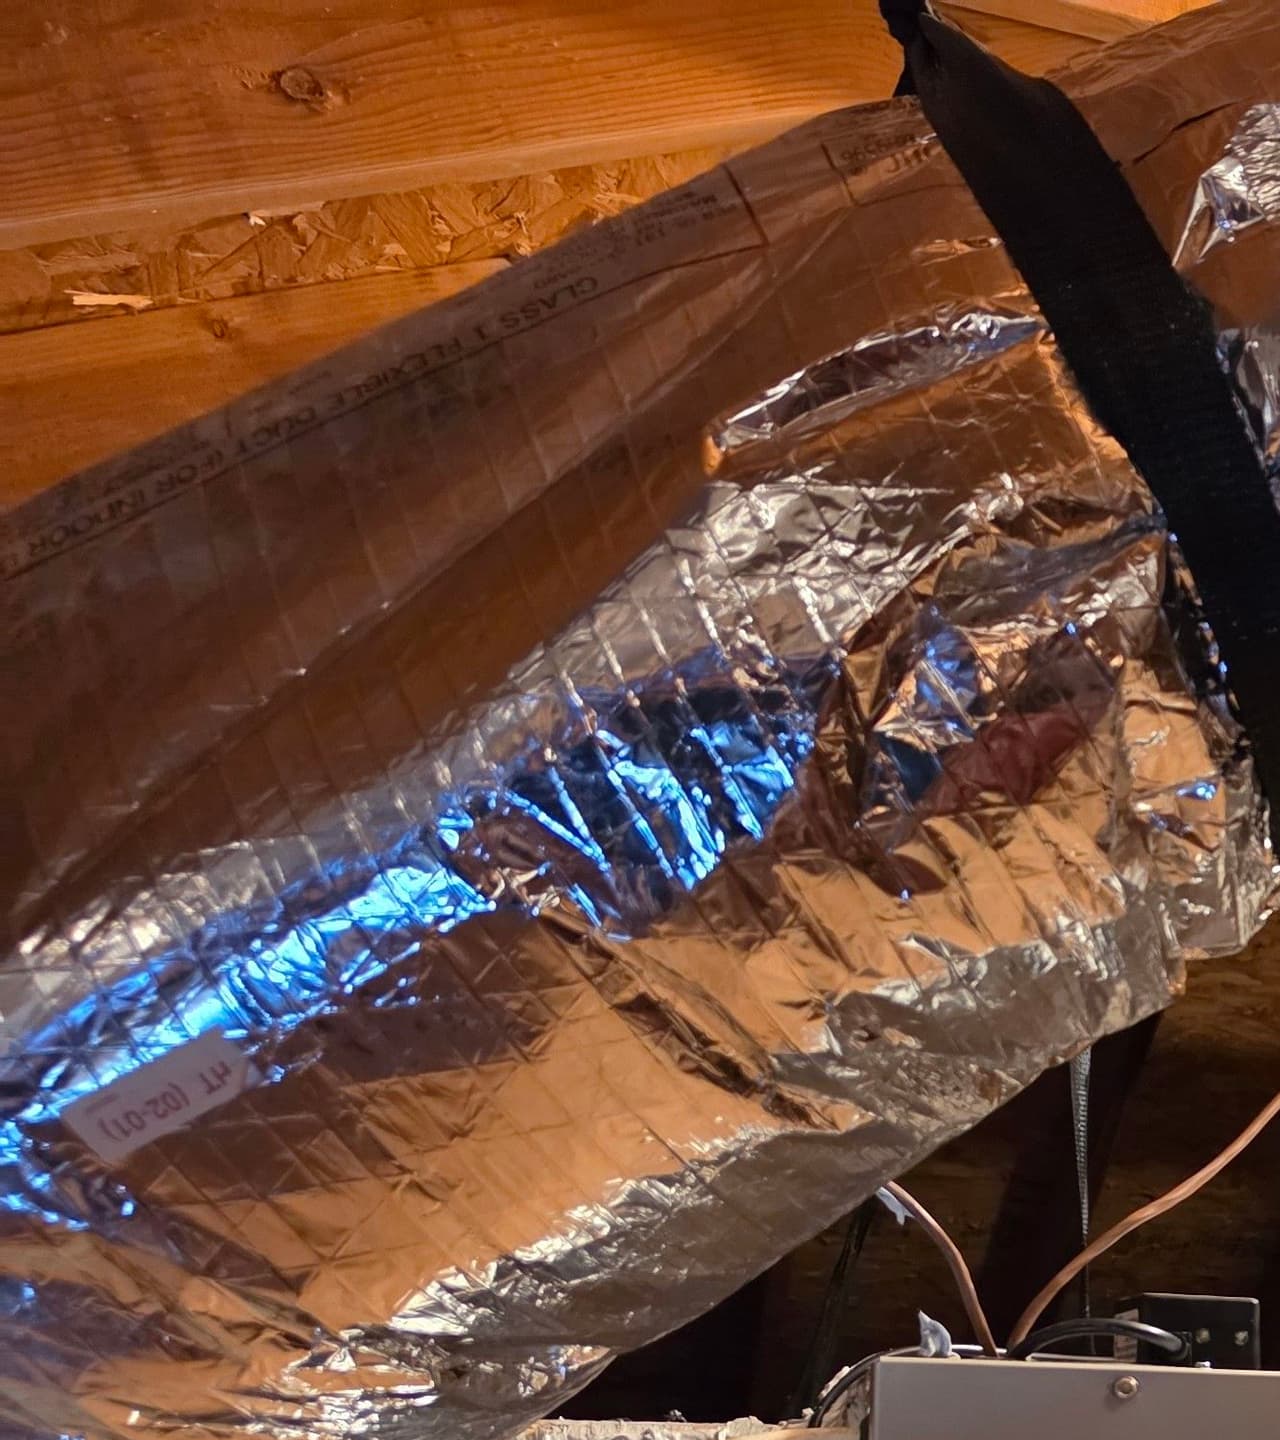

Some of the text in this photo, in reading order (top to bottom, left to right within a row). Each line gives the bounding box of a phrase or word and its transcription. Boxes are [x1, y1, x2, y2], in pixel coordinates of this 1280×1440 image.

[500, 276, 599, 329] CLASS
[331, 338, 464, 406] FLEXIBLE
[238, 407, 318, 453] DUCT
[100, 1083, 192, 1143] (02-01)
